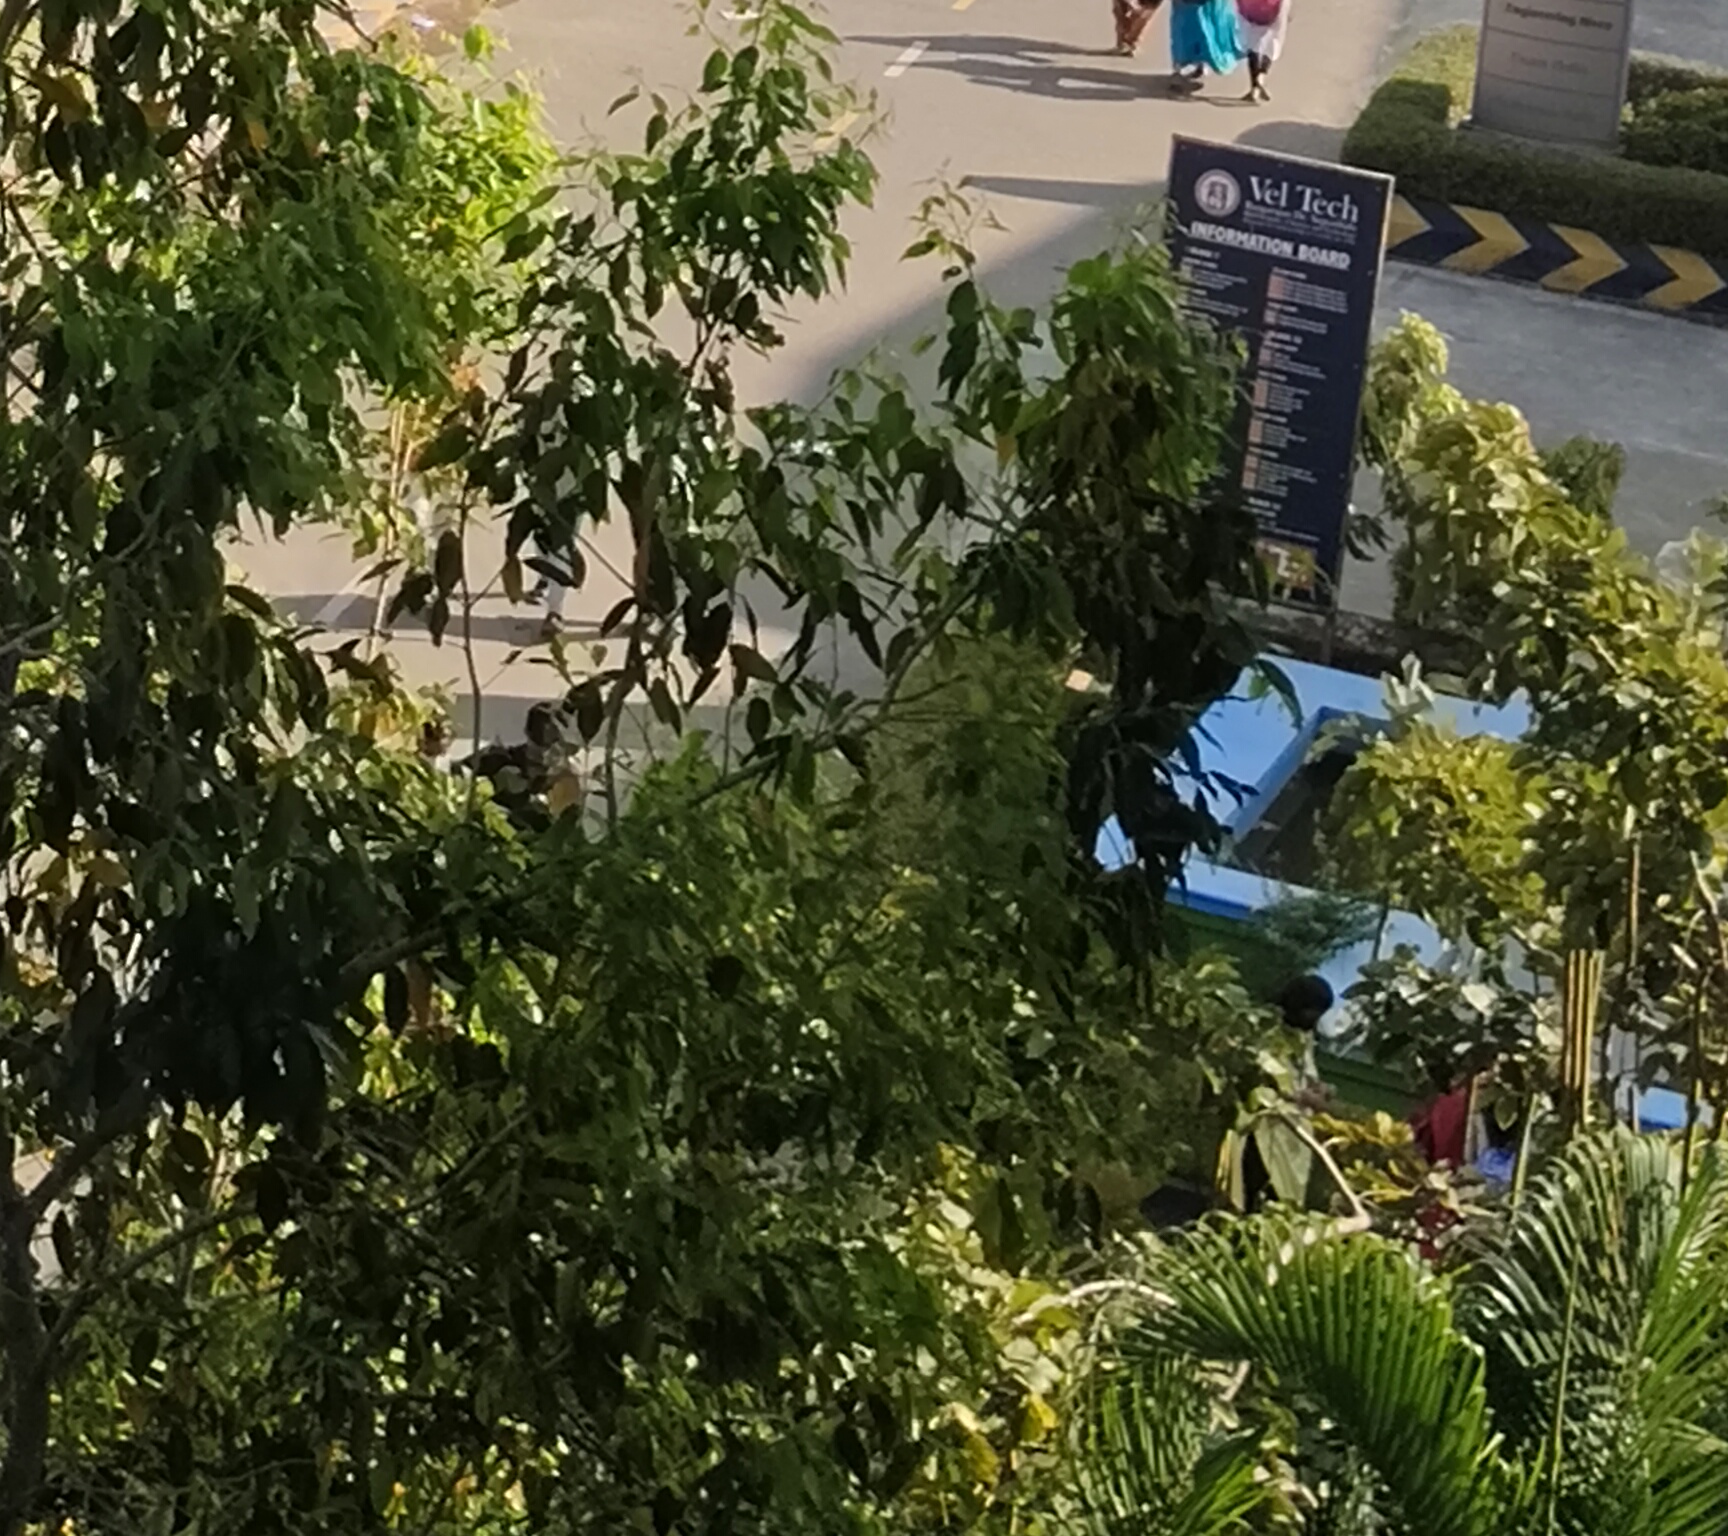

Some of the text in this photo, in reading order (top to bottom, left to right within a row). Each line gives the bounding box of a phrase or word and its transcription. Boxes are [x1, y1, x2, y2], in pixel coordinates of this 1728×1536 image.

[1248, 175, 1288, 208] Vel
[1294, 184, 1359, 223] Tech
[1190, 221, 1295, 255] INFORMATION
[1297, 243, 1351, 269] BOARD
